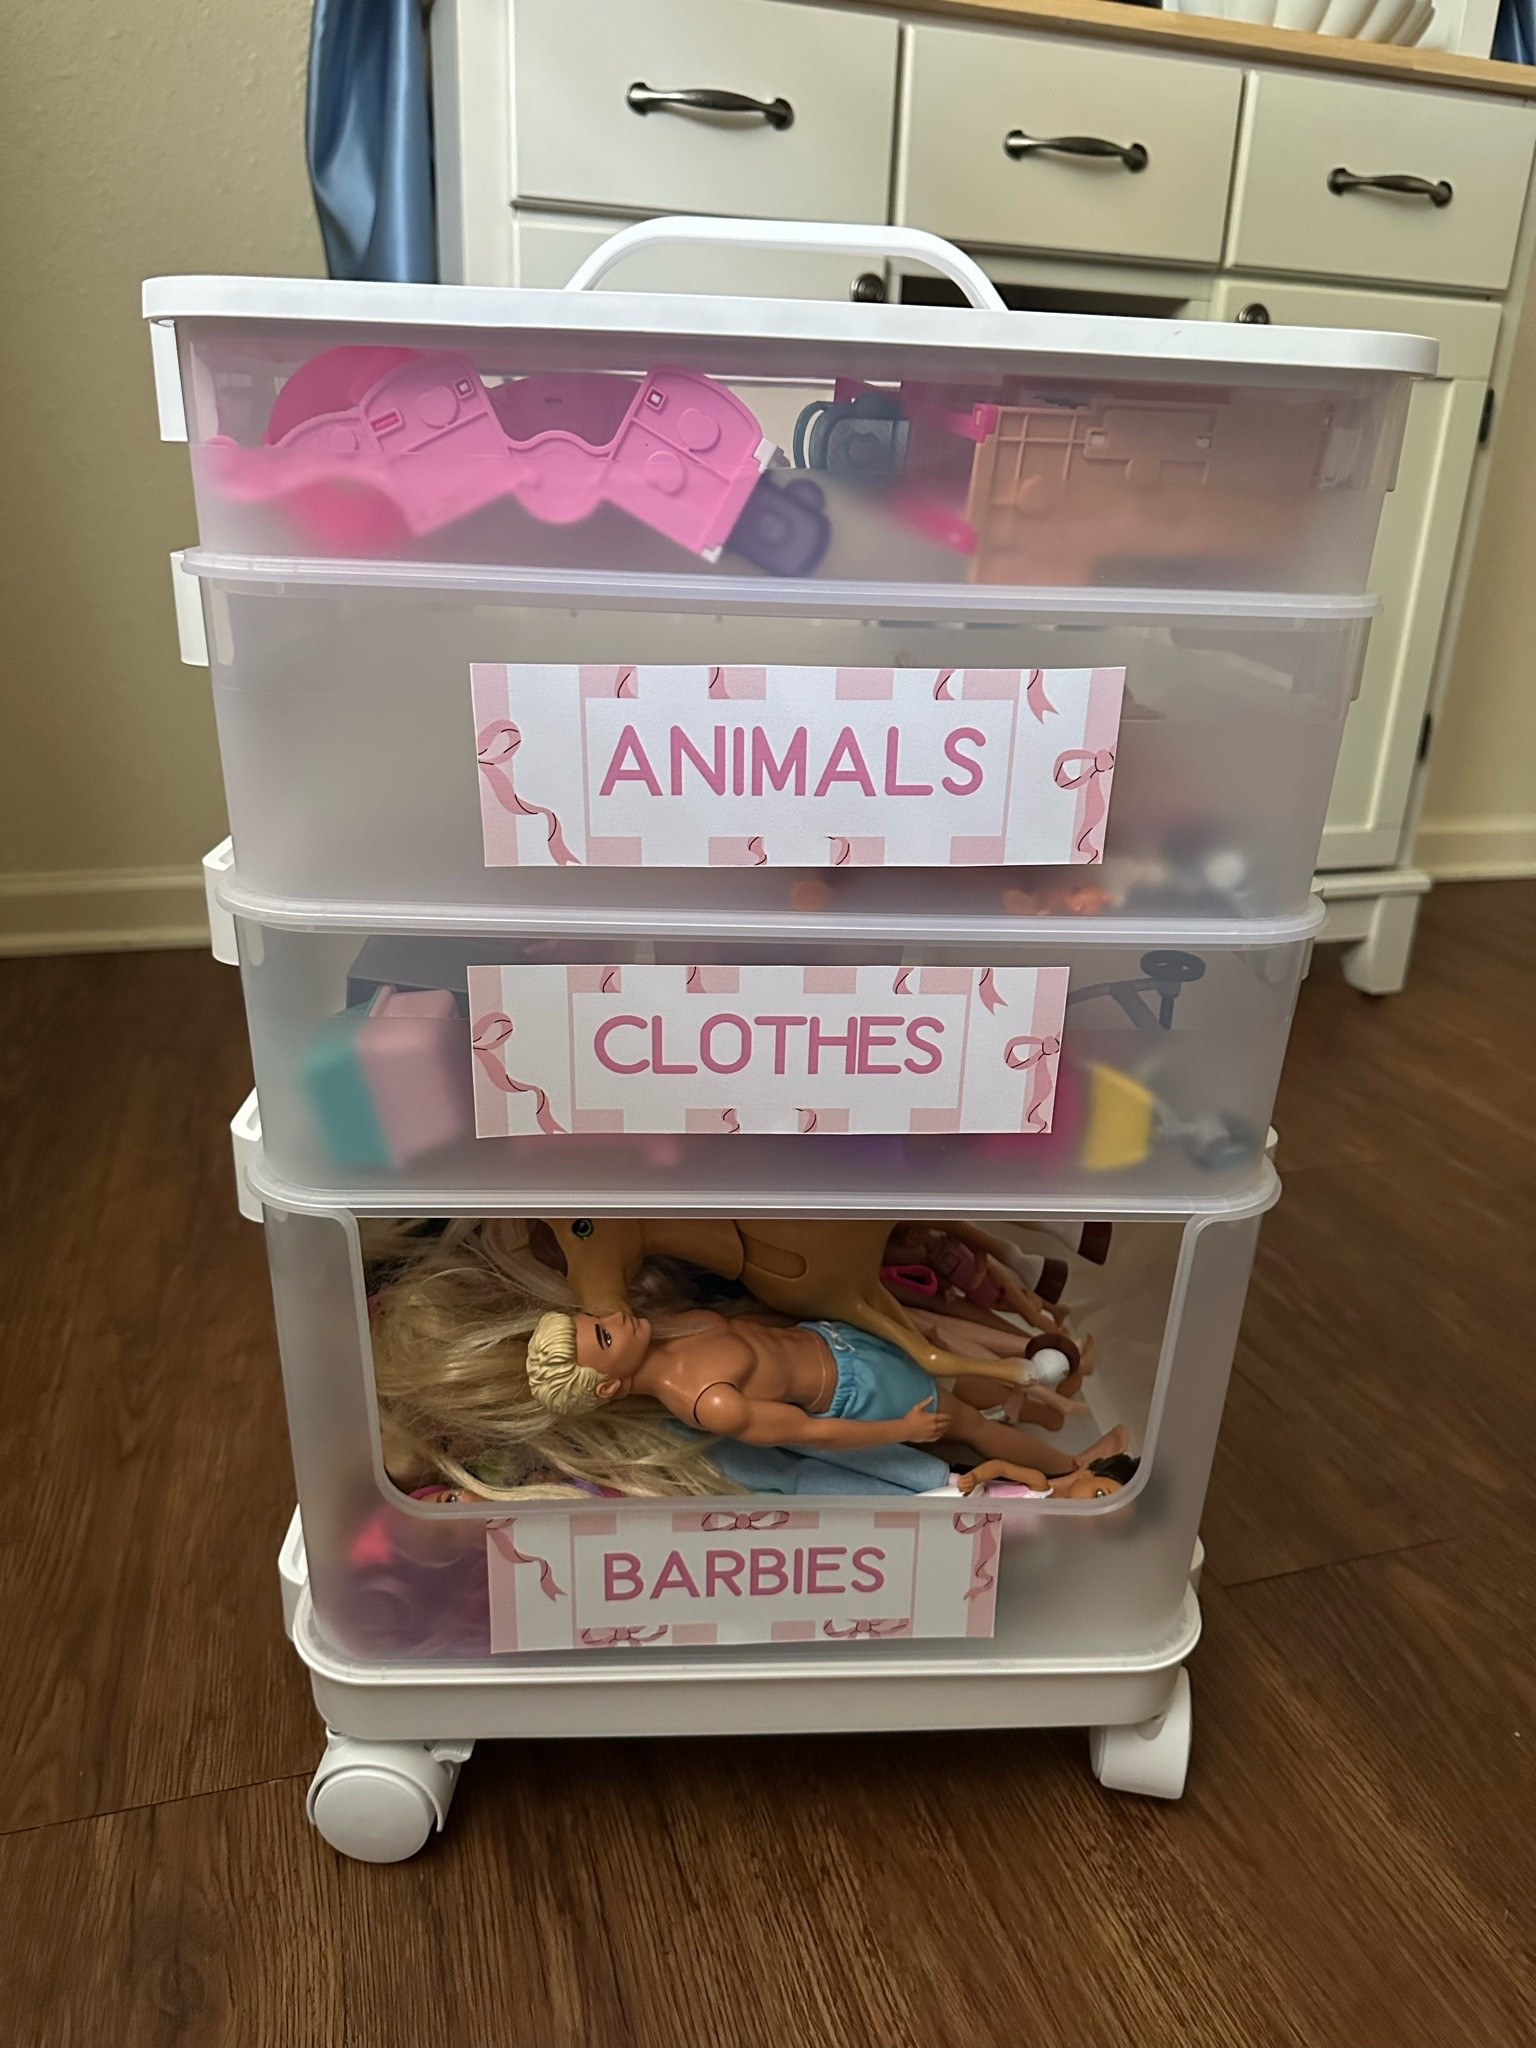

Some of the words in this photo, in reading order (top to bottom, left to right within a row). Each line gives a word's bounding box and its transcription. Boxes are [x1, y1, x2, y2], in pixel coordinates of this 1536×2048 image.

[601, 726, 985, 797] ANIMALS
[595, 1013, 945, 1075] CLOTHES
[604, 1547, 885, 1601] BARBIES
